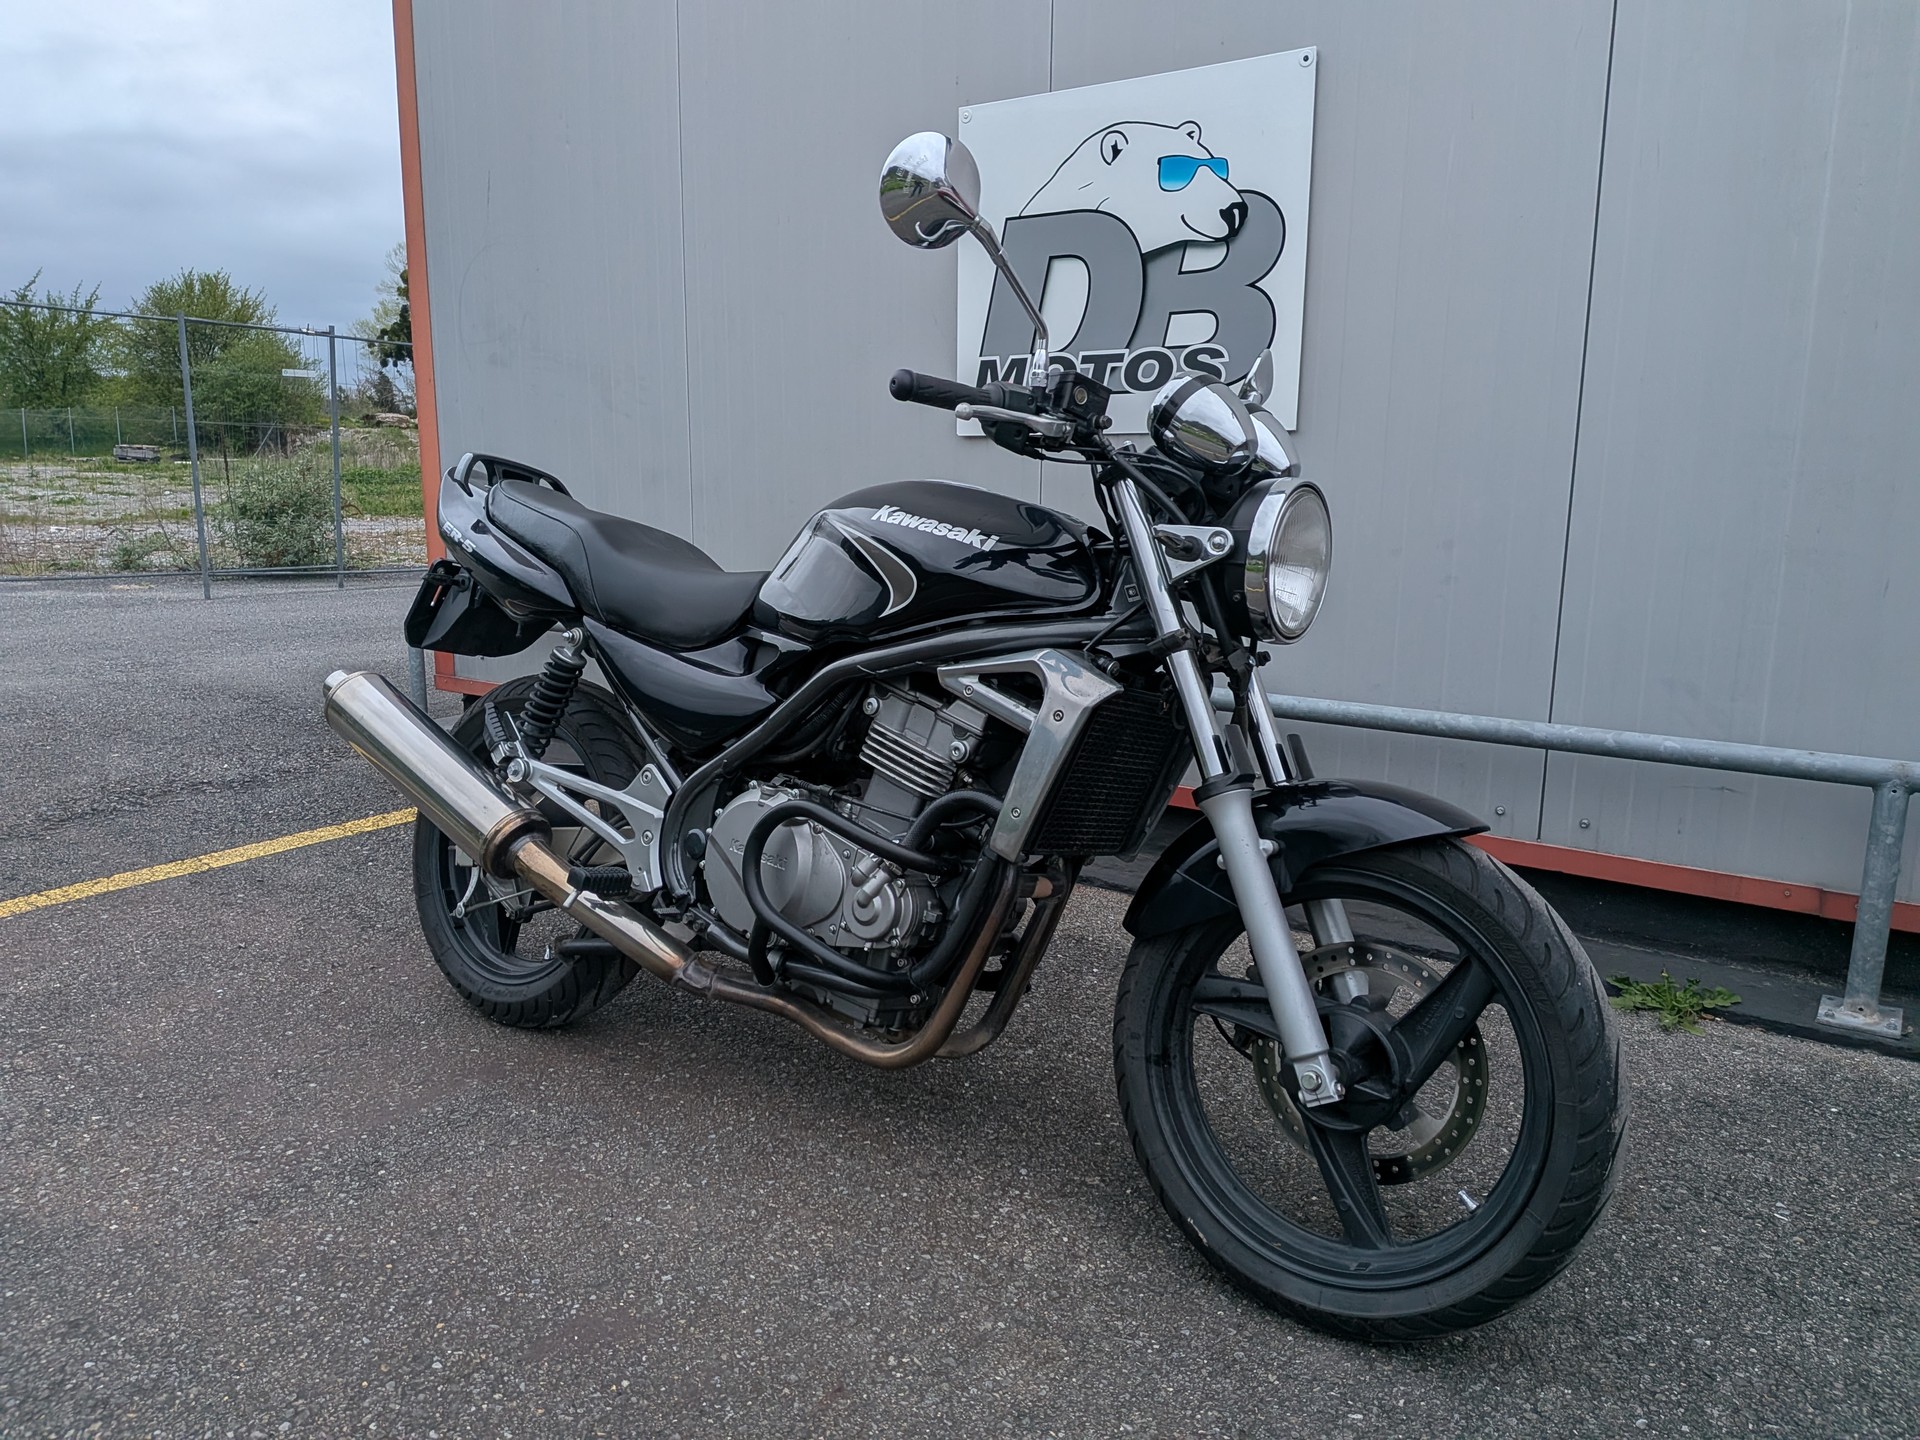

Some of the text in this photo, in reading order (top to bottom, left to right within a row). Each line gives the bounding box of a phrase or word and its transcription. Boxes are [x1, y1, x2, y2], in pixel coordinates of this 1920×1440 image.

[441, 520, 477, 553] ER-5
[871, 504, 1000, 551] Kawasaki
[729, 837, 788, 871] Kasaki
